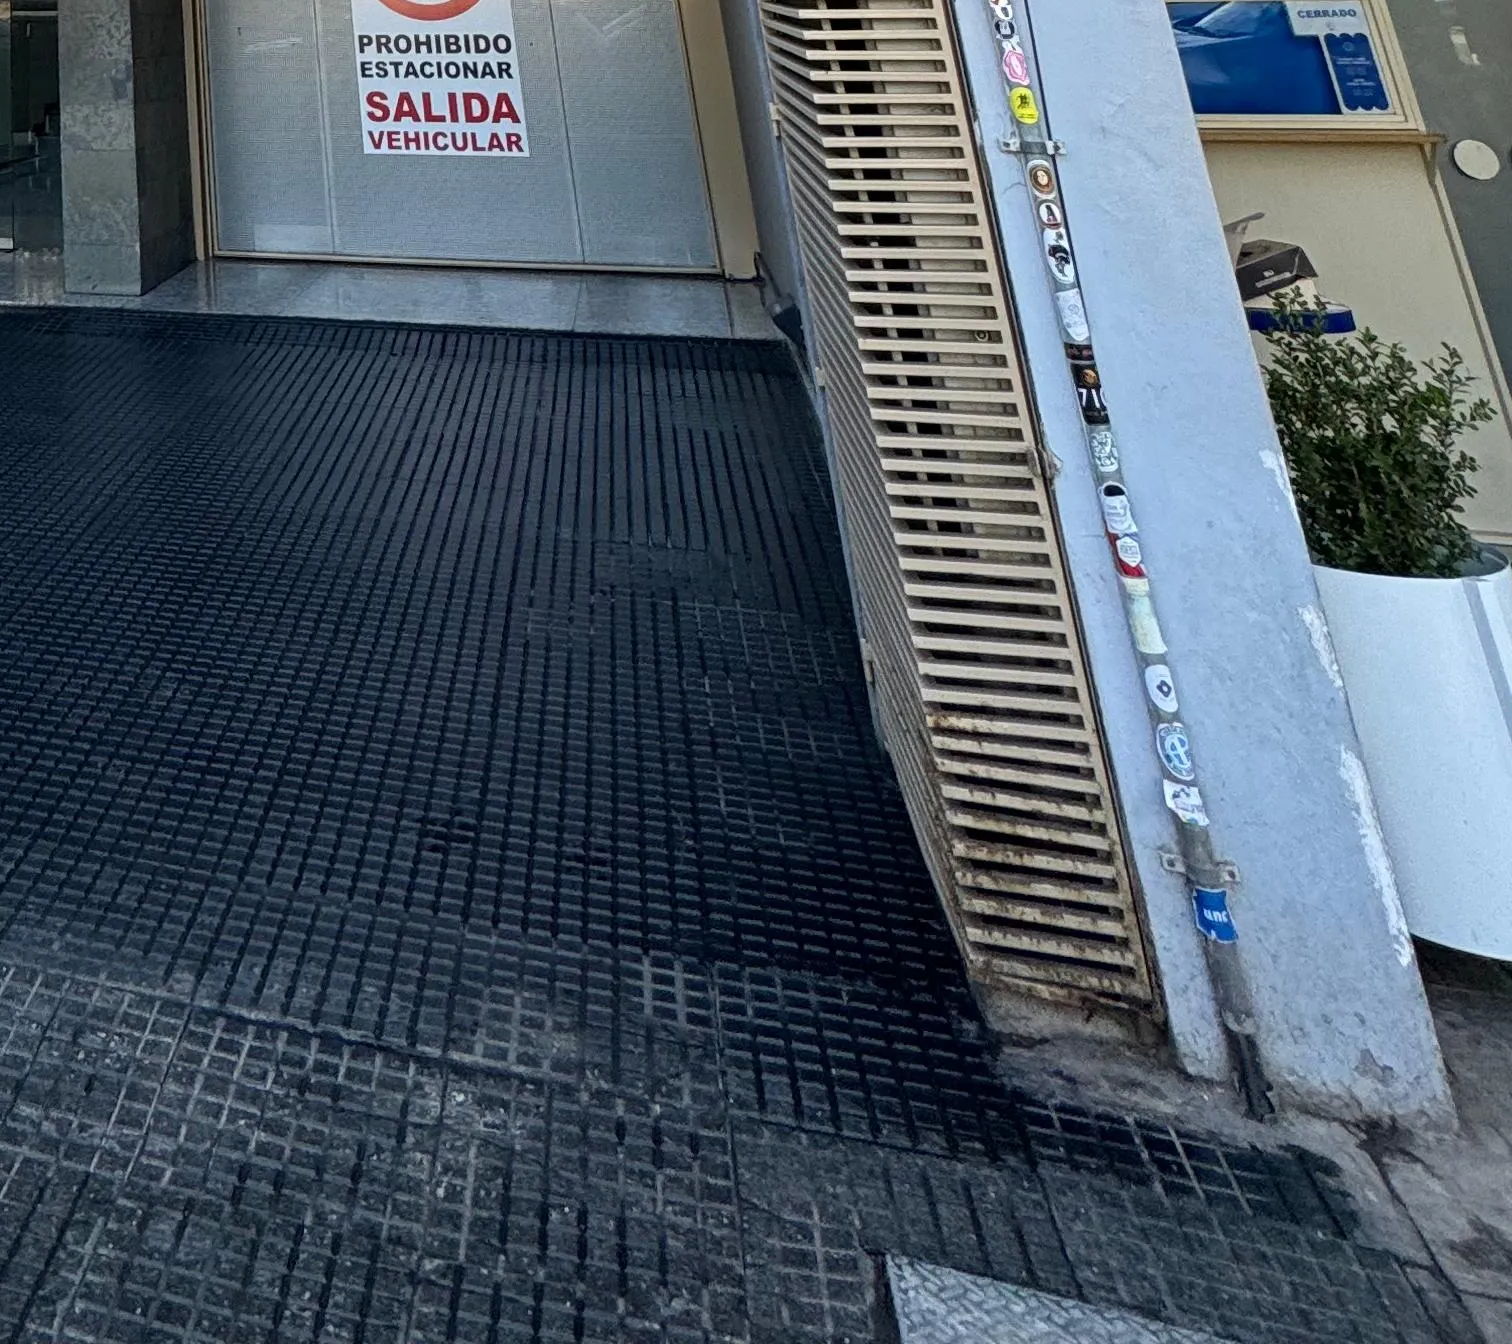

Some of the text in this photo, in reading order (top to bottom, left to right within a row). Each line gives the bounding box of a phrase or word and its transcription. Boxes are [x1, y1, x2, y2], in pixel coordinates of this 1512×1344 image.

[358, 34, 512, 54] PROHIBIDO
[360, 61, 514, 79] ESTACIONAR
[365, 90, 521, 124] SALIDA
[367, 130, 524, 152] VEHICULAR
[1203, 908, 1228, 922] unc
